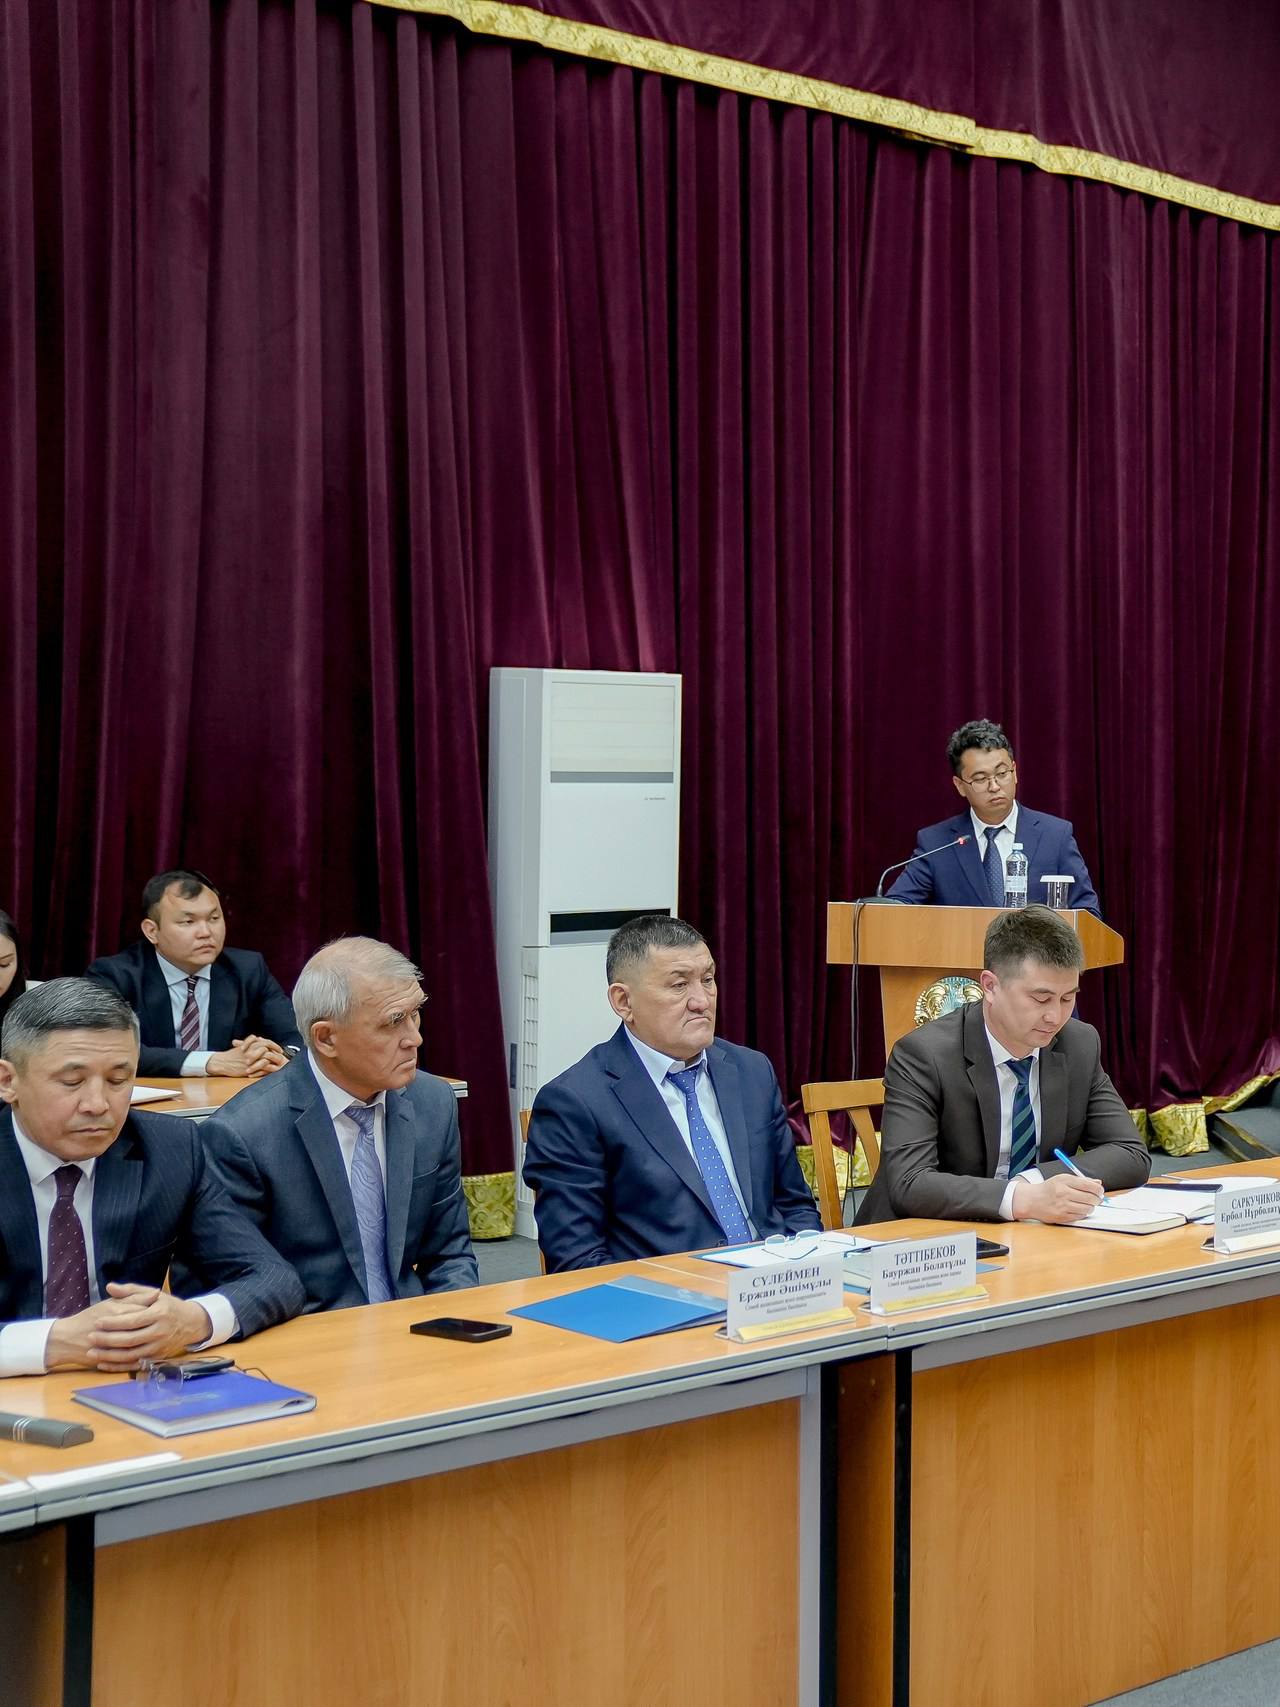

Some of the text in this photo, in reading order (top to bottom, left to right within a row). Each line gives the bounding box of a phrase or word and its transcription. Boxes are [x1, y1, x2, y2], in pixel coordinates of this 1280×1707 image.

[1231, 1192, 1280, 1209] САРКУЧИКОВ
[1221, 1209, 1243, 1224] Ербол
[894, 1244, 956, 1266] ТӘТТІБЕКОВ
[752, 1266, 820, 1288] СҮЛЕЙМЕН
[882, 1265, 920, 1280] Бауржан
[923, 1258, 966, 1272] Болатұлы
[739, 1288, 776, 1303] Ержан
[779, 1278, 832, 1296] Әшімұлы
